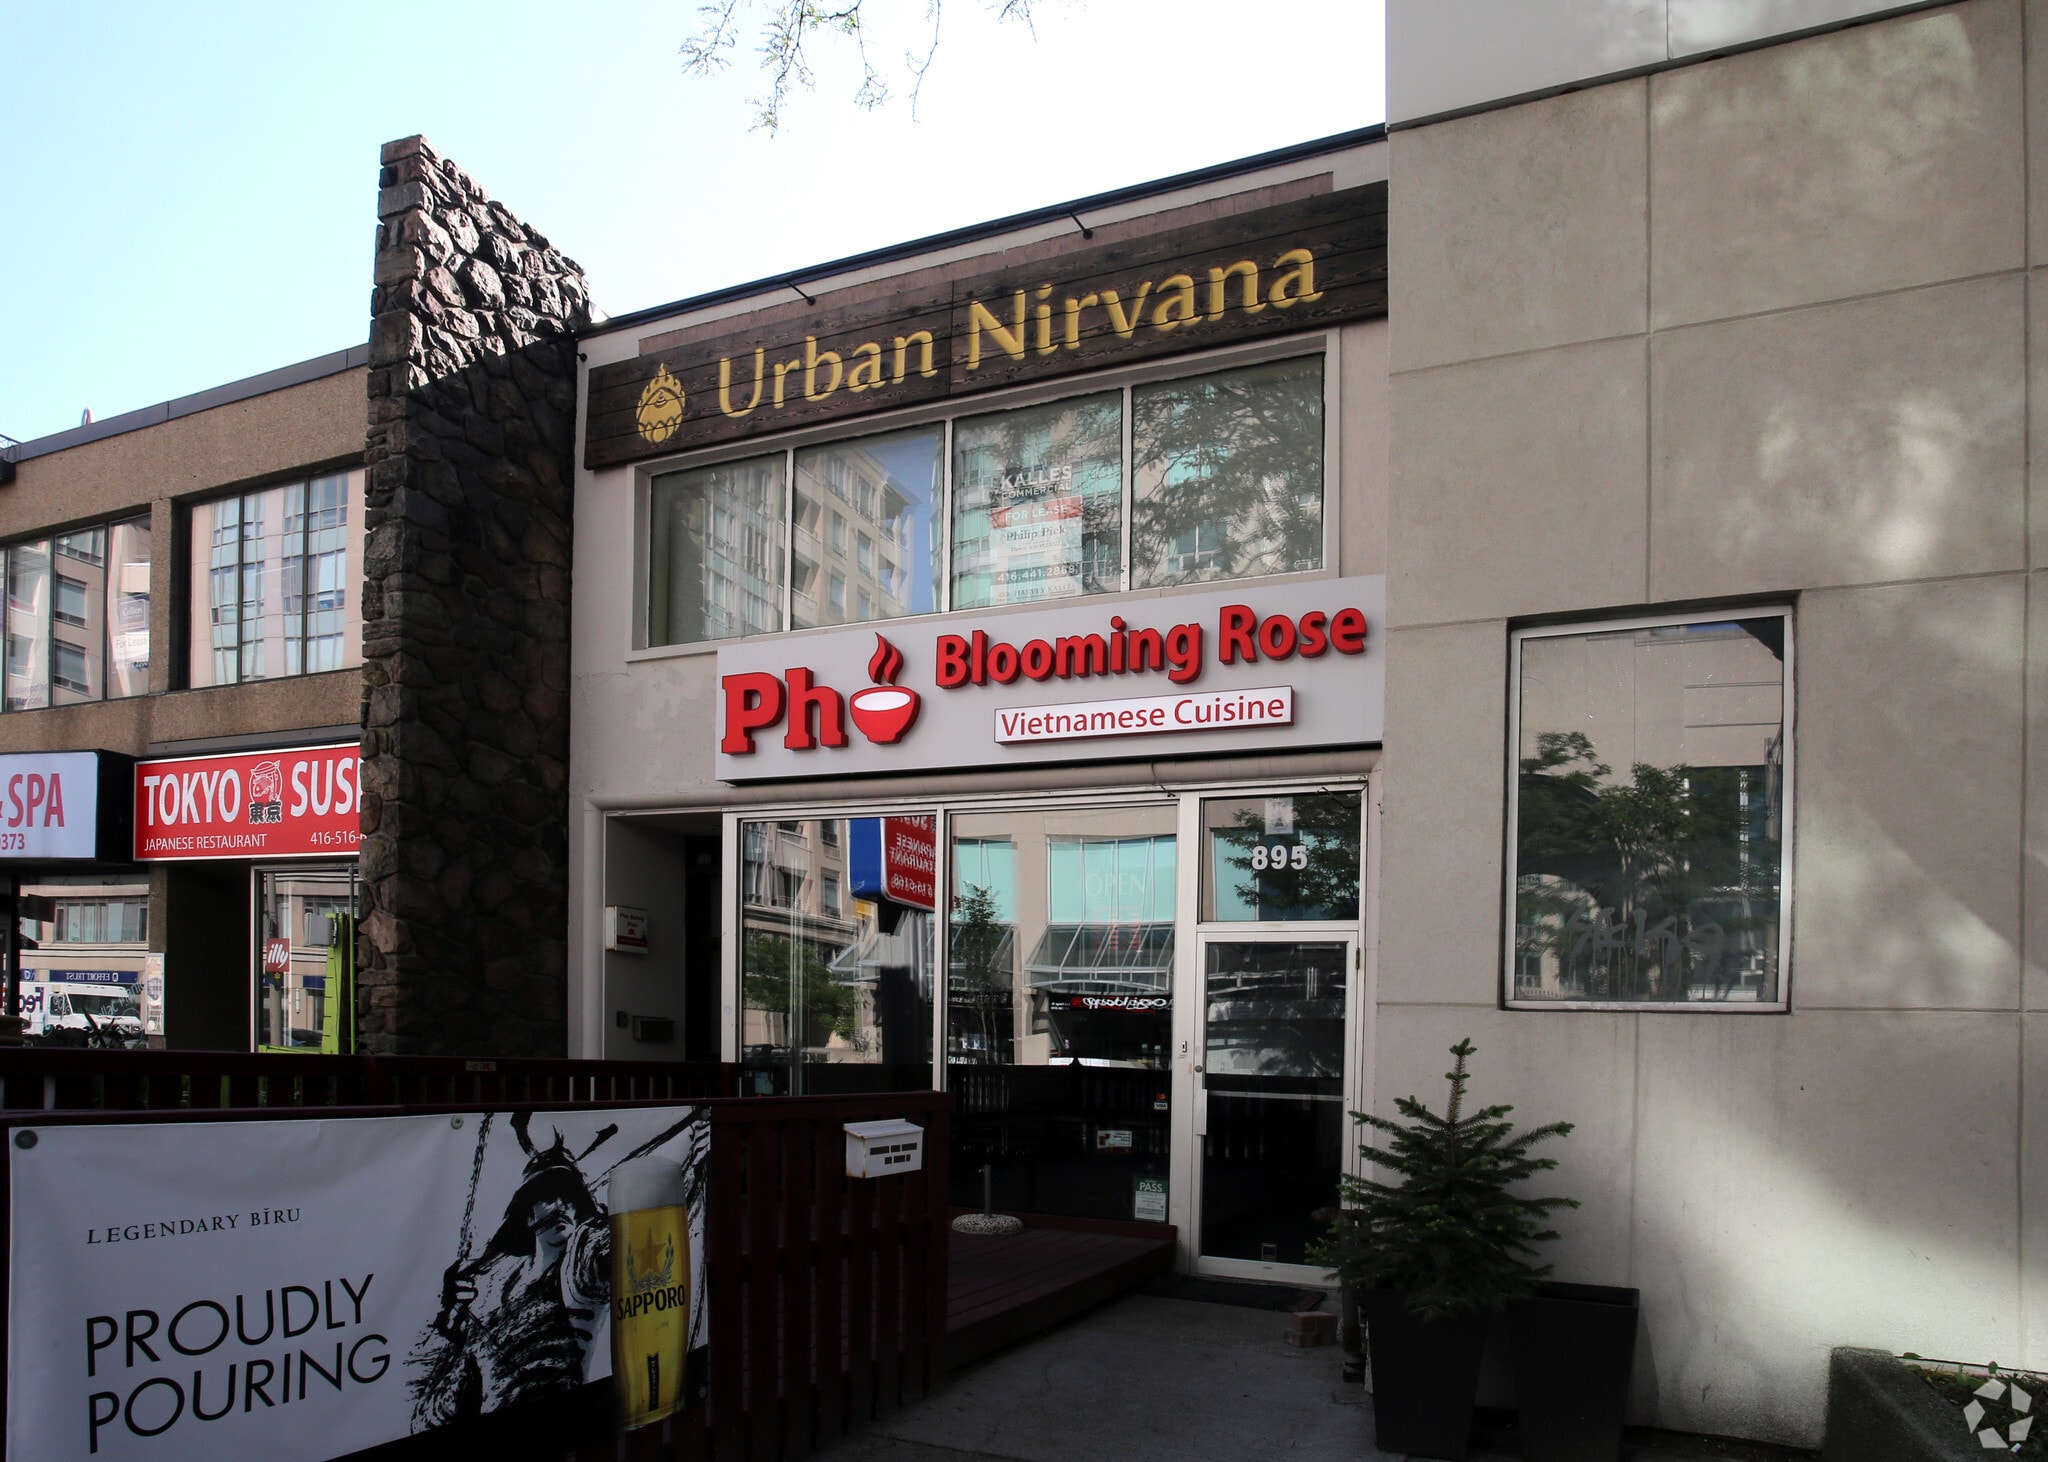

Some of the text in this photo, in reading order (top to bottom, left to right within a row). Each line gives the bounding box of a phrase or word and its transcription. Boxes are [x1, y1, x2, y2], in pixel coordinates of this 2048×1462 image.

[717, 246, 1326, 418] Urban Nirvana
[1001, 465, 1072, 490] KALLES
[1001, 482, 1072, 500] COMMERCIAL
[1005, 505, 1068, 522] FOR LEASE
[1006, 525, 1067, 542] Philip Pick
[936, 604, 1368, 689] Blooming Rose
[1001, 696, 1286, 738] Vietnamese Cuisine
[8, 773, 65, 828] SPA
[144, 768, 241, 826] TOKYO
[0, 833, 26, 850] 373
[144, 833, 267, 852] JAPANESE RESTAURANT
[1251, 845, 1308, 871] 895
[1086, 873, 1145, 897] OPEN
[267, 943, 288, 968] illy
[1139, 1181, 1163, 1193] PASS
[86, 1212, 242, 1245] LEGENDARY
[616, 1282, 688, 1322] SAPPORO
[84, 1272, 376, 1378] PROUDLY
[87, 1332, 393, 1455] POURING
